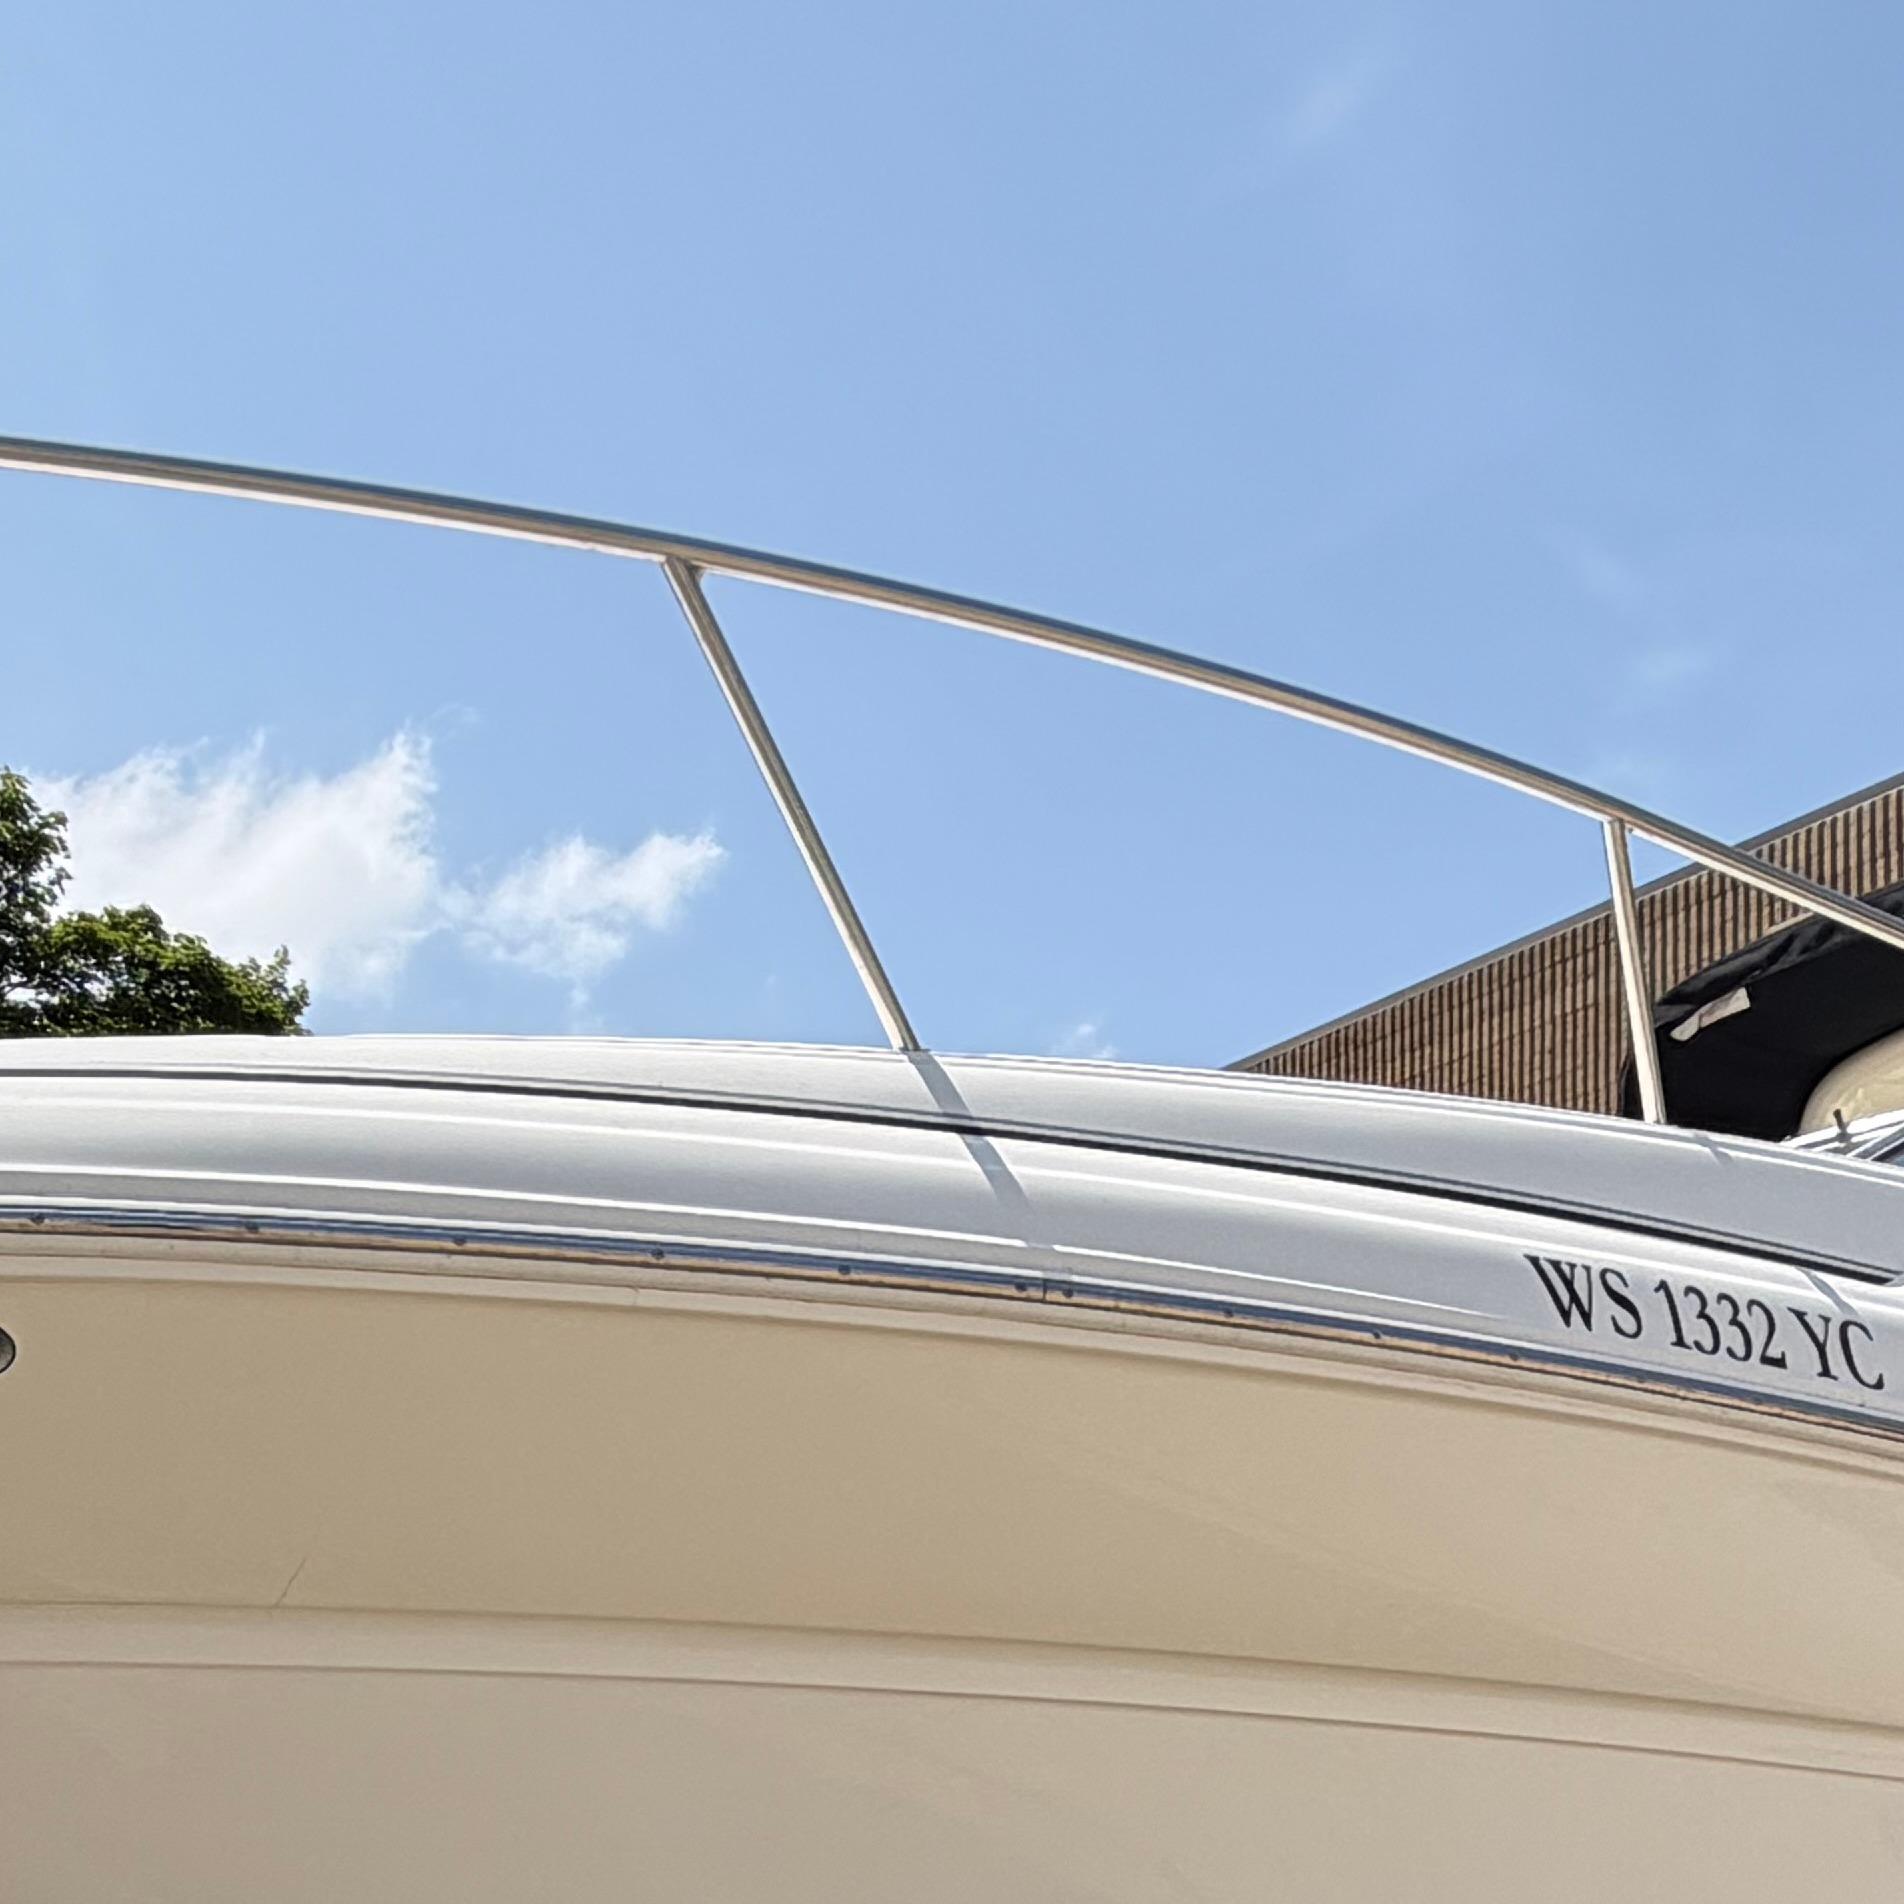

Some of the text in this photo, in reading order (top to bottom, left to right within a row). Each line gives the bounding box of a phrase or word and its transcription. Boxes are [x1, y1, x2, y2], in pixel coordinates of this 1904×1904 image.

[1523, 1254, 1885, 1390] WS 1332 YC
